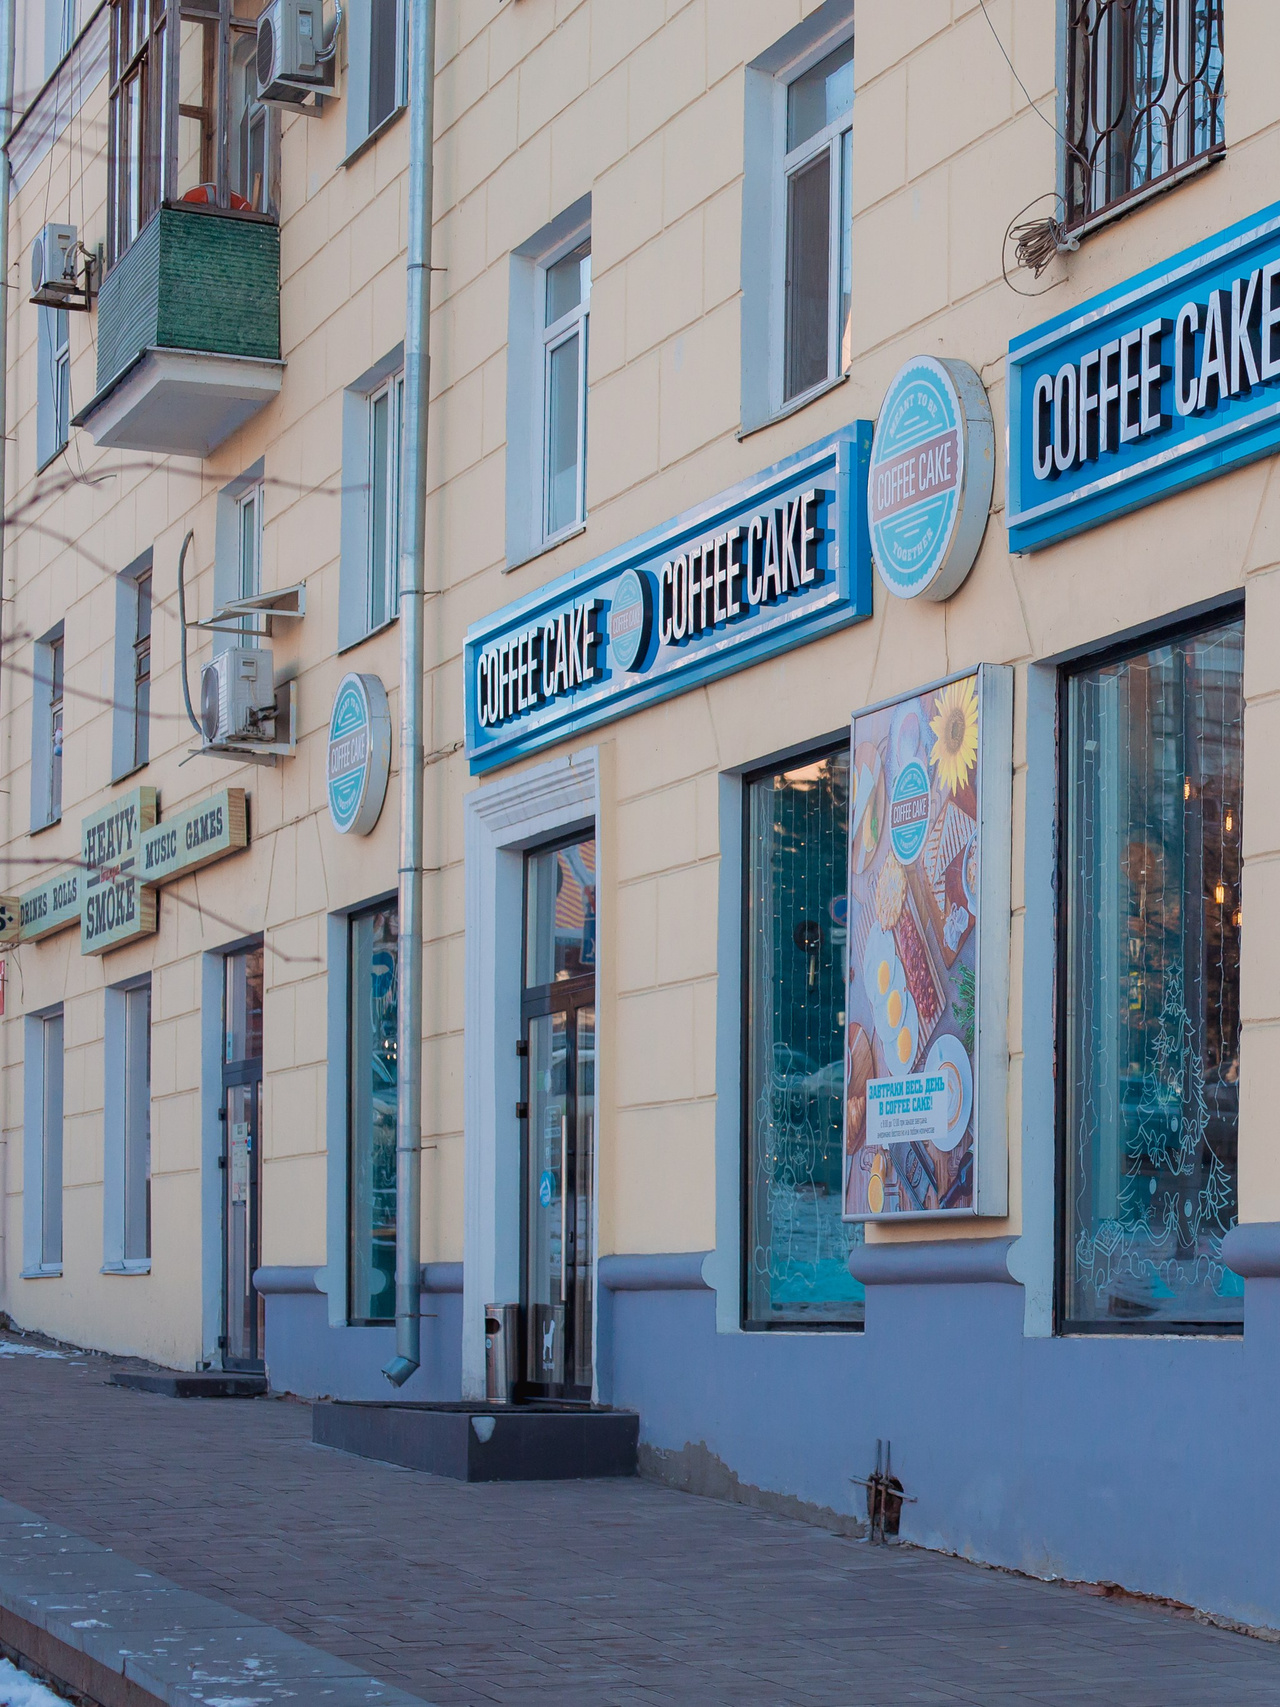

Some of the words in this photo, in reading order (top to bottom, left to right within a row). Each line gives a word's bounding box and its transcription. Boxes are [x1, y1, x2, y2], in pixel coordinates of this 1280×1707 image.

[889, 394, 915, 439] MEANT
[917, 392, 928, 407] TO
[925, 398, 938, 419] BE
[1031, 317, 1162, 481] COFFEE
[877, 456, 916, 512] COFFEE
[918, 440, 952, 493] CAKE
[658, 525, 742, 646] COFFEE
[746, 488, 816, 605] CAKE
[893, 527, 934, 562] TOGETHER
[613, 612, 629, 635] COFFEE
[477, 626, 538, 727] COFFEE
[542, 598, 596, 697] CAKE
[331, 739, 350, 774] COFFEE
[350, 733, 366, 766] CAKE
[893, 802, 912, 824] COFFEE
[912, 797, 927, 818] CAKE
[86, 804, 135, 871] HEAVY
[145, 829, 177, 870] MUSIC
[185, 806, 223, 850] GAMES
[20, 892, 48, 927] DRINKS
[52, 877, 77, 911] ROLLS
[86, 876, 135, 940] SMOKE
[868, 1081, 904, 1100] ЗАВТРАКИ
[905, 1079, 924, 1095] ВЕСЬ
[925, 1076, 945, 1095] ДЕНЬ
[885, 1098, 911, 1115] COFFEE
